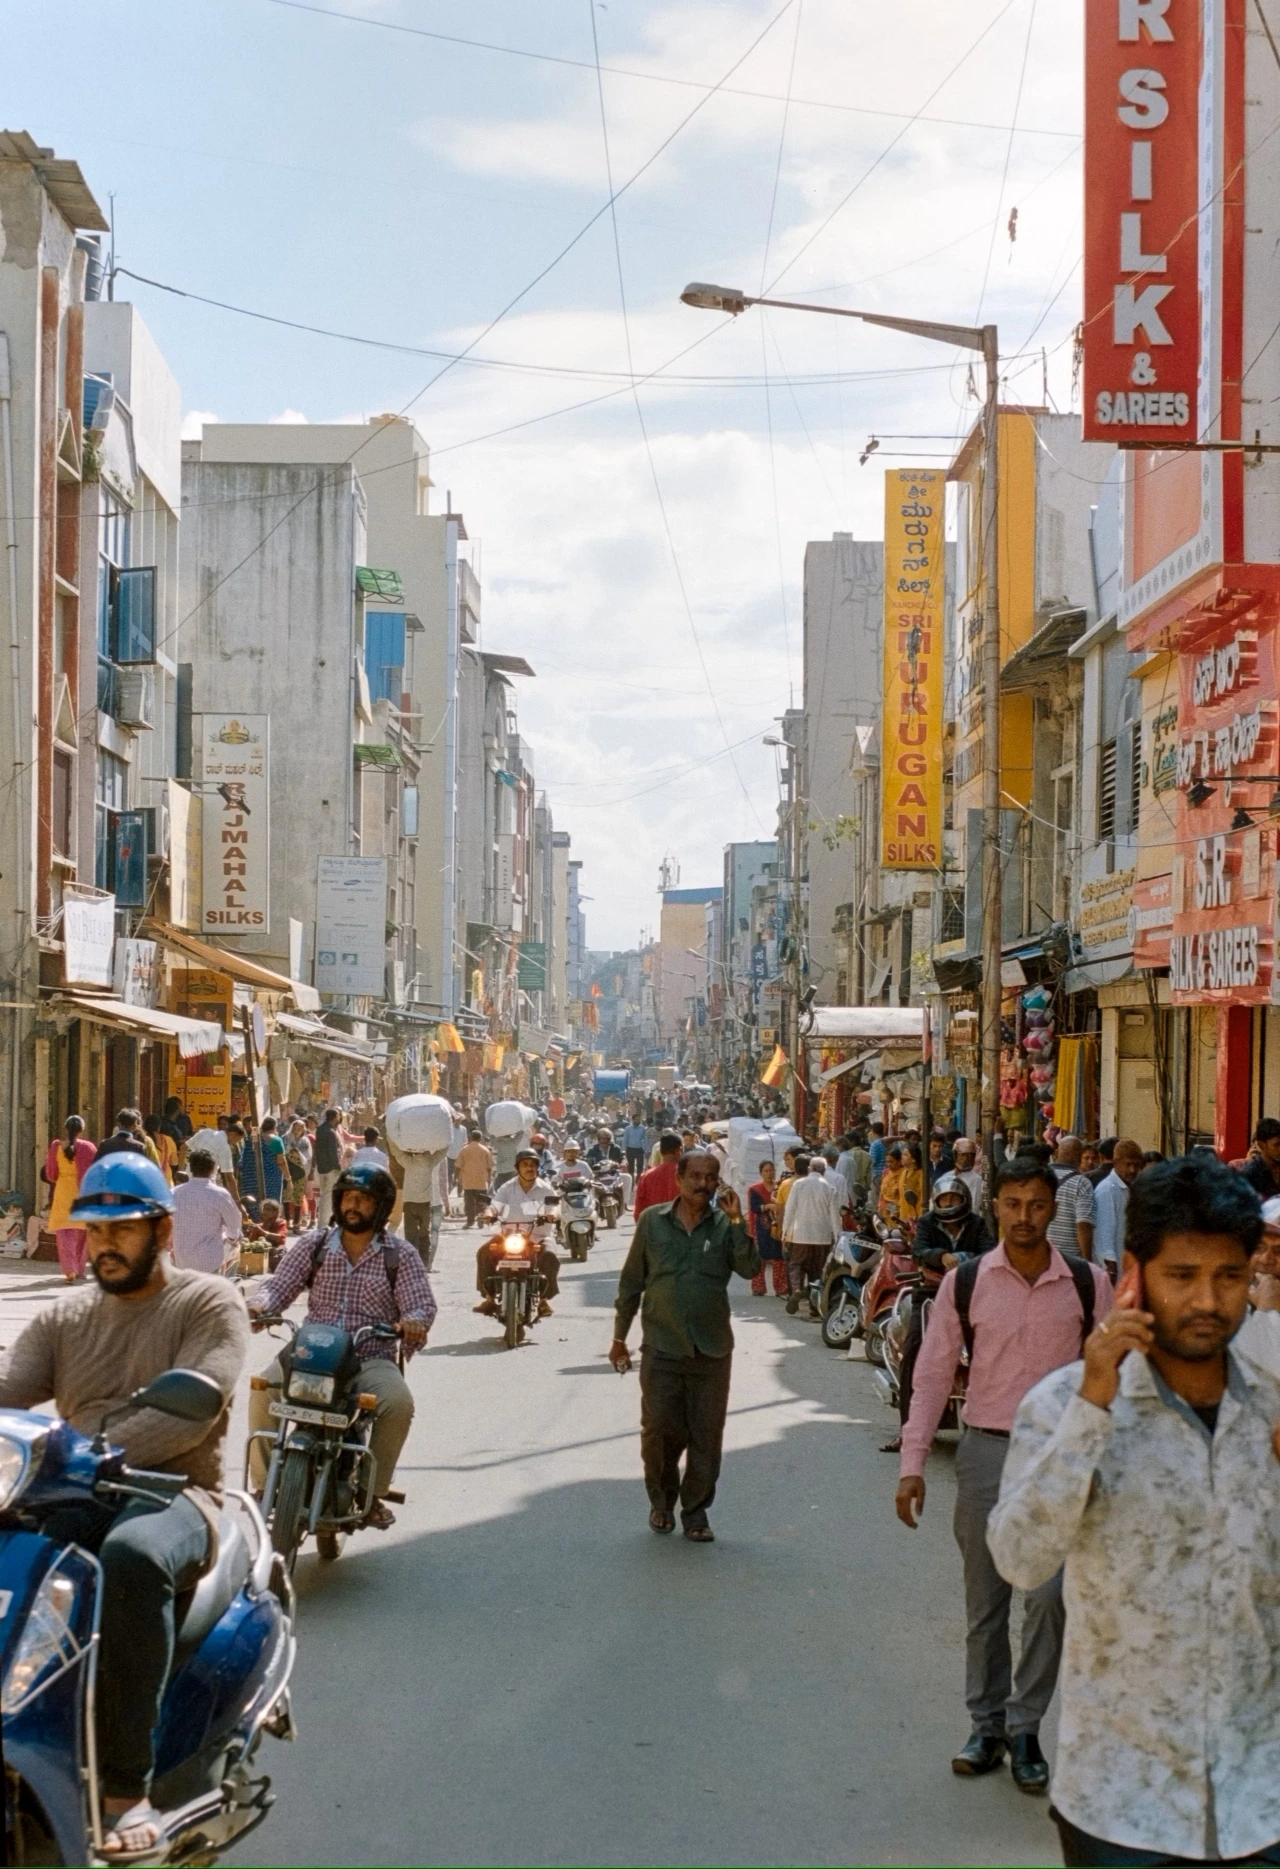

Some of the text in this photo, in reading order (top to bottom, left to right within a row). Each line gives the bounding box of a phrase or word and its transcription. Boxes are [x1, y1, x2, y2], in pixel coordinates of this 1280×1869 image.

[1113, 68, 1175, 346] SILK
[1131, 352, 1157, 387] &
[1096, 391, 1189, 426] SAREES
[898, 614, 932, 628] SRI
[897, 631, 931, 838] MURUGAN
[221, 782, 248, 908] RAJMAHAL
[887, 843, 936, 862] SILKS
[1196, 835, 1231, 910] S.R.
[206, 911, 264, 925] SILKS
[1170, 934, 1194, 991] SILK
[1197, 931, 1206, 989] &
[1209, 926, 1258, 989] SAREES
